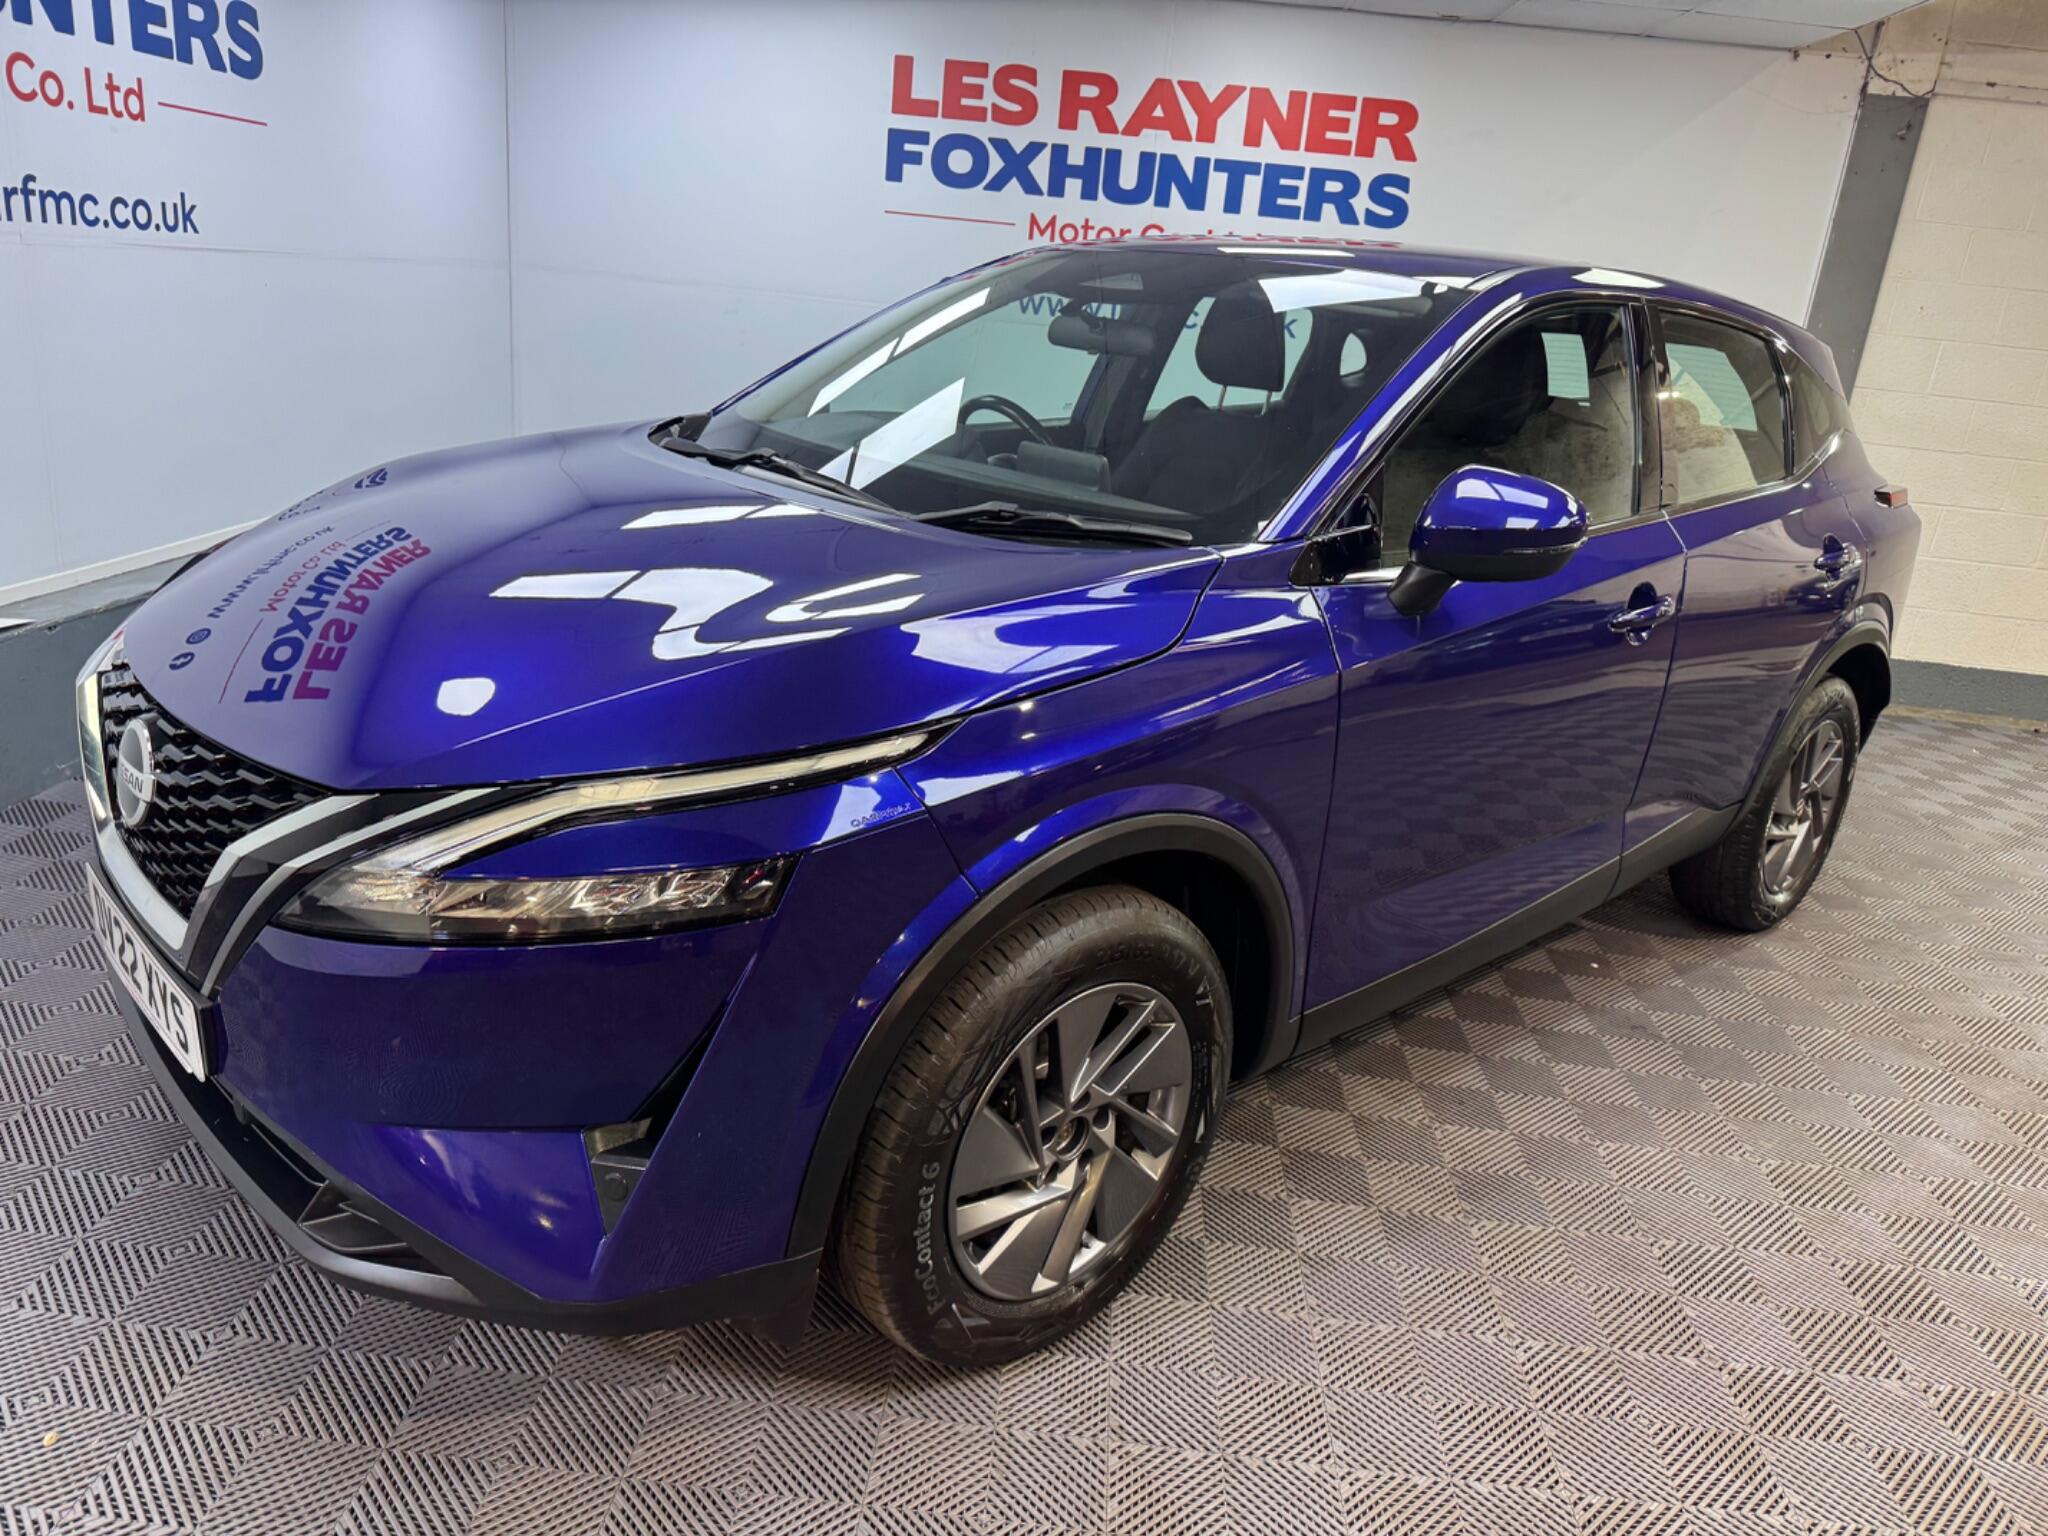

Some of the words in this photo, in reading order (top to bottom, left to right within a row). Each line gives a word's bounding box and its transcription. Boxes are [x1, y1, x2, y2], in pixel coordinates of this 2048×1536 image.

[5, 51, 74, 110] Co.
[84, 67, 145, 121] Ltd
[891, 54, 1038, 126] LES
[1058, 70, 1419, 162] RAYNER
[0, 173, 199, 234] rfmc.co.uk
[885, 128, 1411, 229] FOXHUNTERS
[141, 952, 188, 1054] XYS
[922, 1161, 940, 1180] 6
